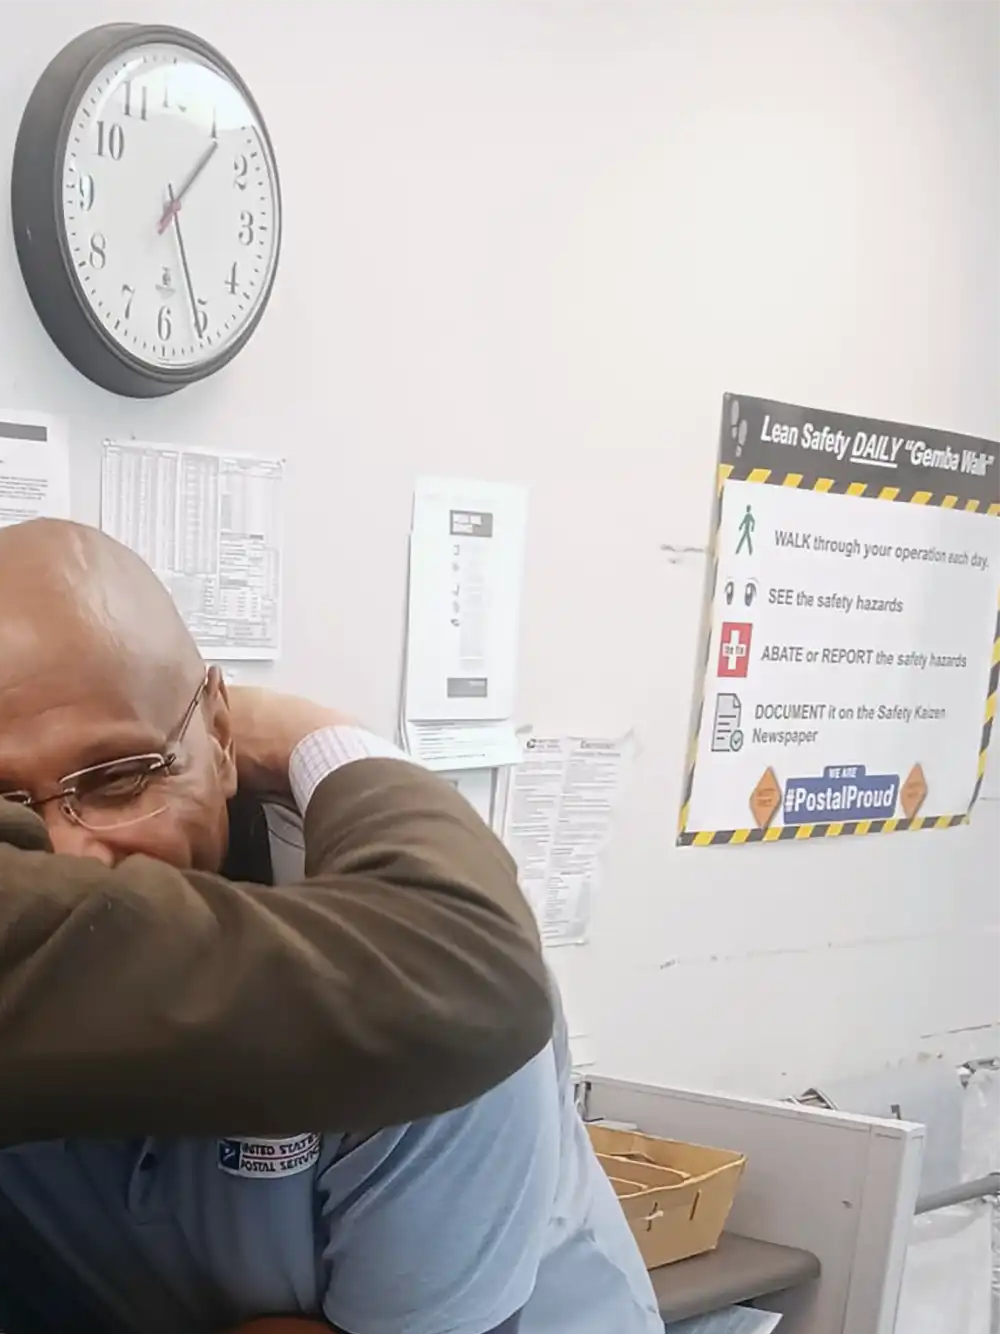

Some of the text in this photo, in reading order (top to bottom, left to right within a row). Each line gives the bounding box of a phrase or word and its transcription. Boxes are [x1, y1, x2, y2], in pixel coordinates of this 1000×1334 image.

[123, 80, 148, 121] 11
[95, 119, 126, 162] 10
[232, 152, 250, 192] 2
[77, 172, 96, 212] 9
[237, 210, 256, 247] 3
[88, 230, 107, 271] 8
[223, 260, 241, 296] 4
[120, 283, 136, 321] 7
[156, 304, 172, 342] 6
[760, 414, 799, 447] Lean
[801, 422, 851, 461] Safety
[851, 431, 905, 465] DAILY
[774, 529, 990, 571] WALK through your operation each day.
[768, 588, 904, 614] SEE the safety hazards
[760, 645, 804, 663] ABATE
[806, 649, 820, 663] or
[821, 648, 874, 665] REPORT
[875, 649, 894, 666] the
[896, 650, 928, 671] safety
[929, 652, 968, 669] hazards
[754, 703, 946, 724] DOCUMENT it on the Safety Kaizen
[752, 727, 819, 747] Newspaper
[828, 767, 858, 779] WE ARE
[783, 783, 896, 813] #PostalProud
